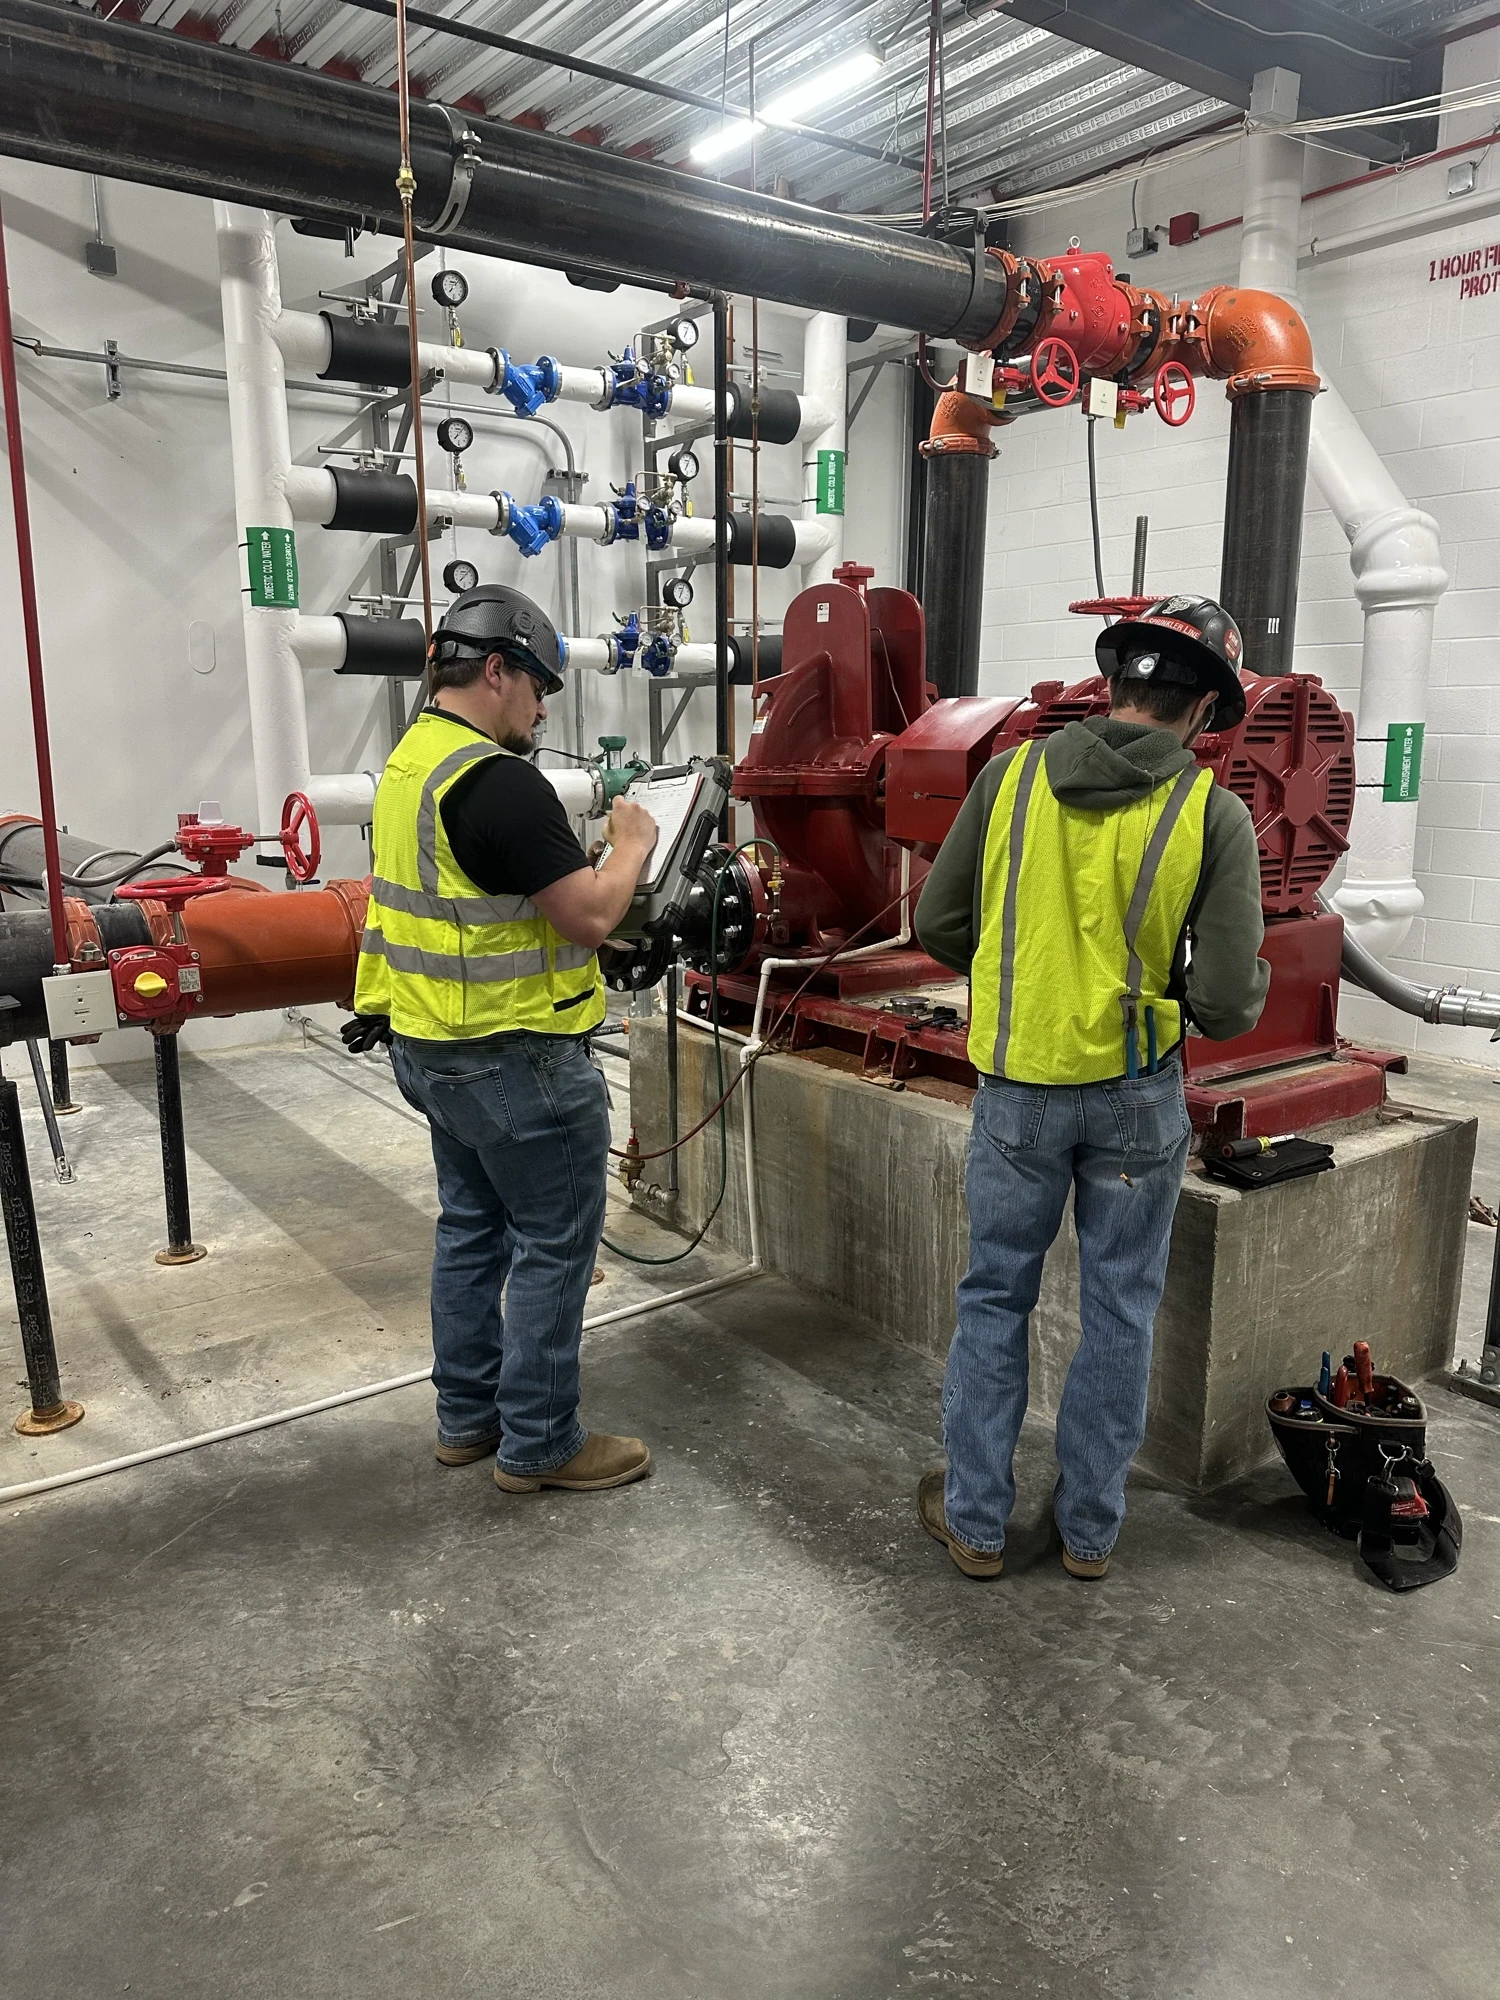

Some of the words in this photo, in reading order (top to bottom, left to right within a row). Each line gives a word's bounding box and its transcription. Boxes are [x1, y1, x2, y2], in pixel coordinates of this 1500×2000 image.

[1429, 260, 1436, 282] 1
[1439, 250, 1482, 280] HOUR
[262, 541, 272, 558] WATER
[263, 560, 272, 573] COLD
[264, 575, 273, 599] DOMESTIC
[1149, 618, 1183, 632] SPRINKLER
[1183, 625, 1200, 640] LINE
[1404, 737, 1413, 754] WATER
[1400, 756, 1411, 796] EXTINGUISHMENT
